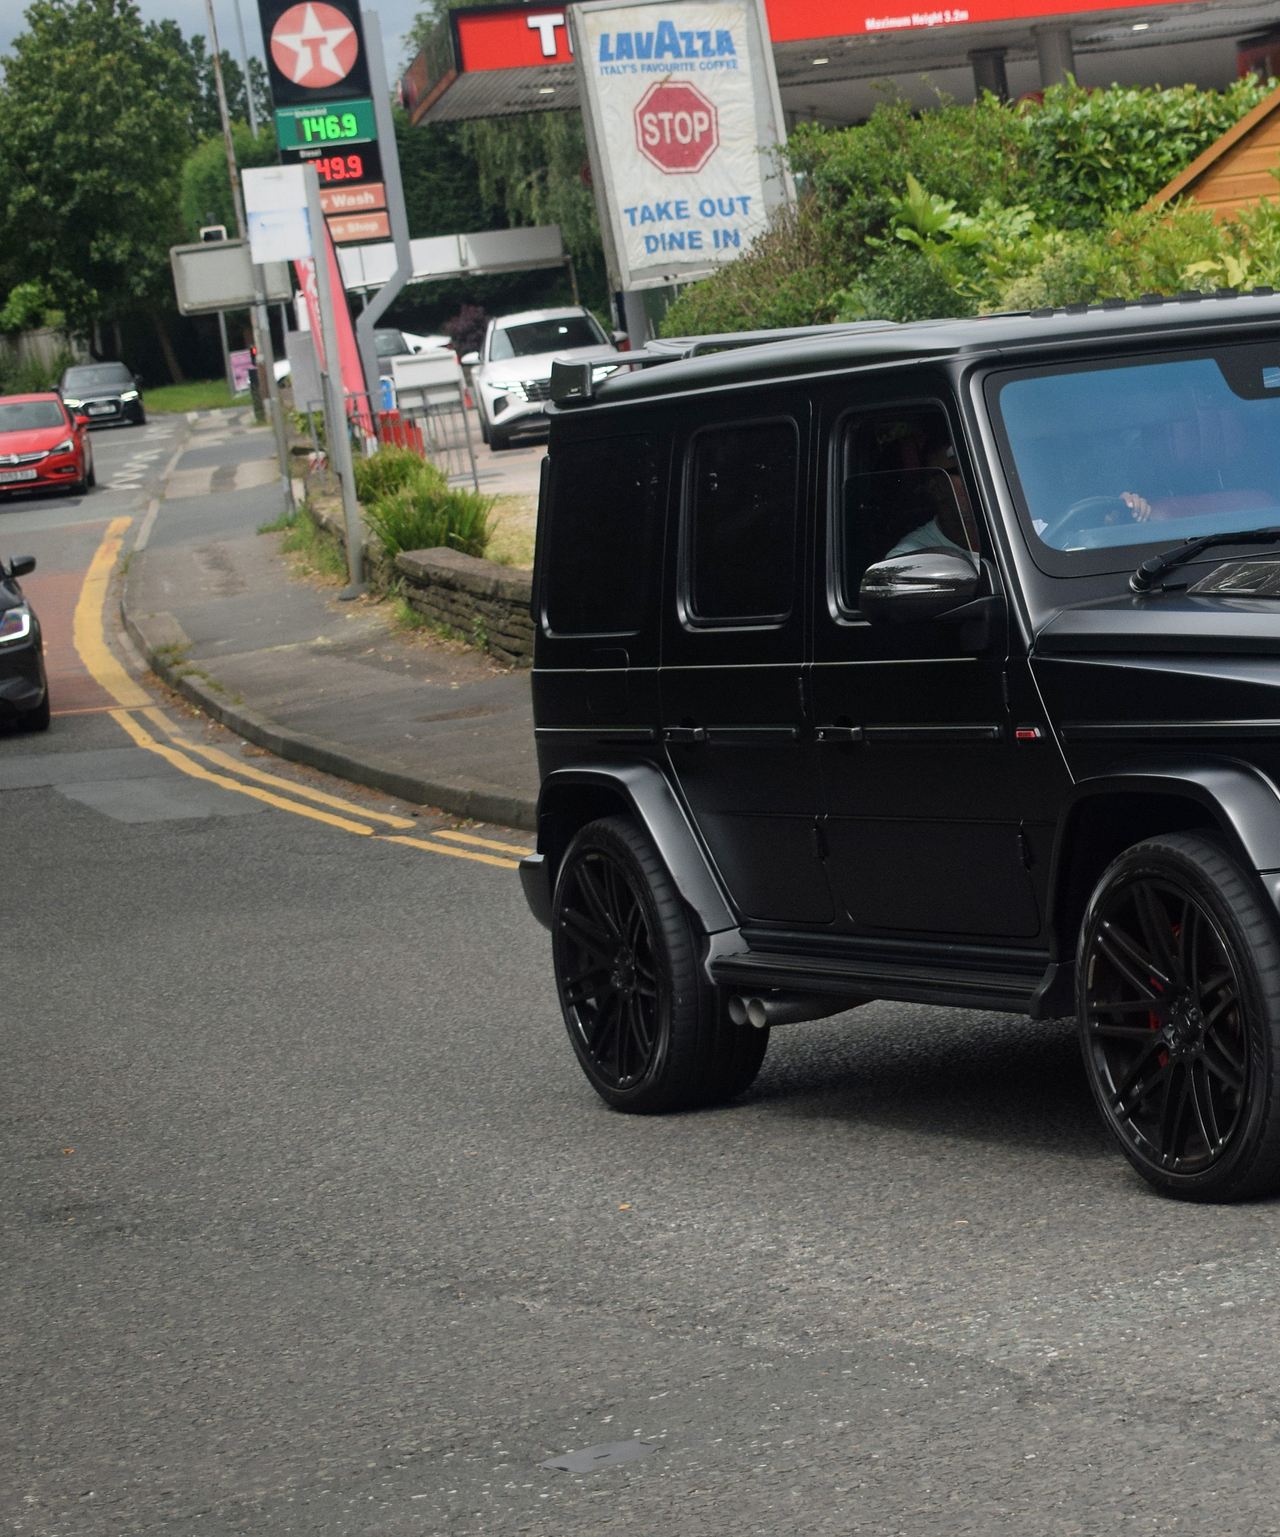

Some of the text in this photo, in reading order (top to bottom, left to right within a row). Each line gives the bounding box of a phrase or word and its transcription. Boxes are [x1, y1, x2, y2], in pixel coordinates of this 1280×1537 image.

[865, 16, 911, 30] Maximum
[912, 11, 943, 26] Height
[600, 20, 737, 63] LAVAZZA
[600, 58, 739, 76] ITALY'S FAVOURITE COFFEE
[302, 113, 358, 141] 146.9
[643, 111, 709, 146] STOP
[308, 155, 363, 180] 49.9
[332, 191, 375, 207] Wash
[624, 196, 751, 227] TAKE OUT
[645, 228, 741, 254] DINE IN
